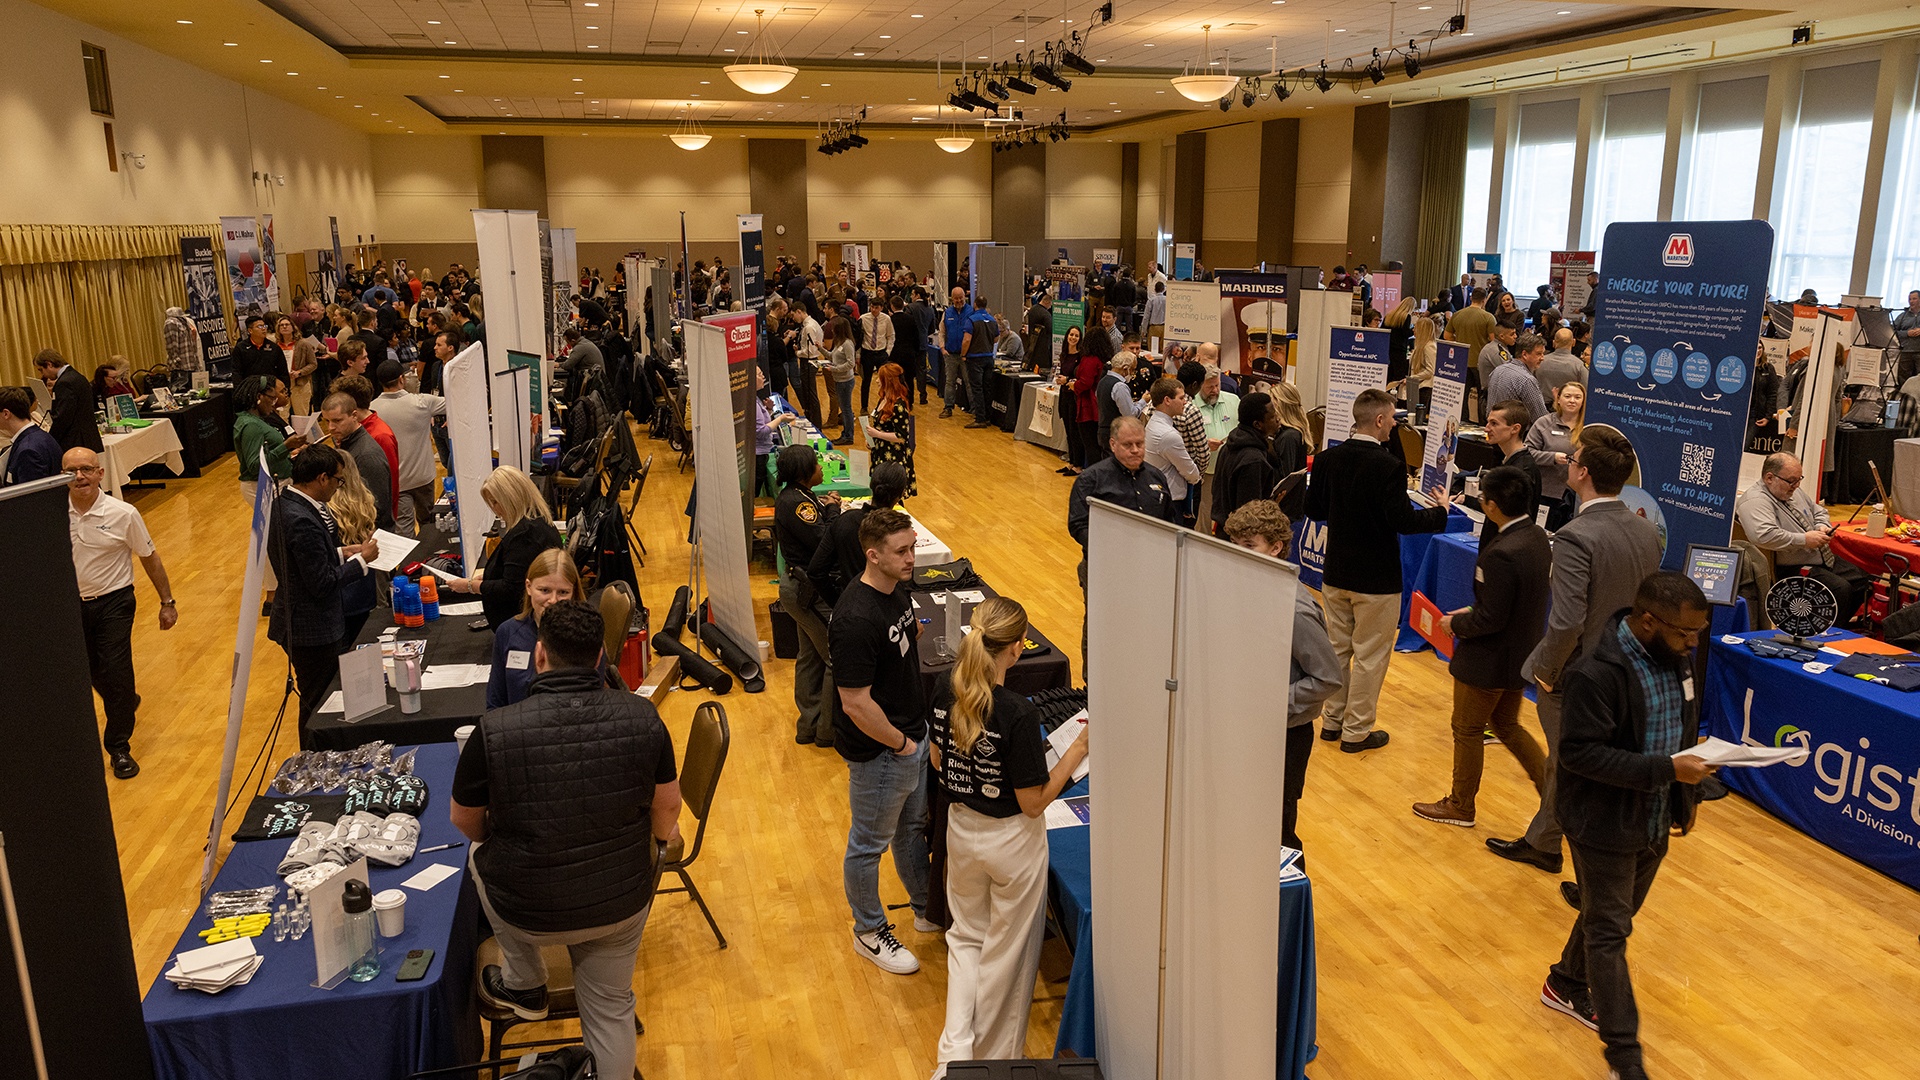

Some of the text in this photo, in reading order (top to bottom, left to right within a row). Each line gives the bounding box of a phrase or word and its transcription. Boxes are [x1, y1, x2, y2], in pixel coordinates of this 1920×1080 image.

[195, 249, 212, 257] Buckle
[1668, 239, 1689, 255] M
[1222, 284, 1284, 294] MARINES
[1607, 277, 1749, 300] ENERGIZE YOUR FUTURE!
[1170, 311, 1199, 321] Enriching
[197, 318, 227, 333] DISCOVER
[212, 330, 228, 344] YOUR
[731, 326, 752, 343] Gilbane
[208, 344, 231, 360] CAREER
[1617, 392, 1633, 401] exciting
[1645, 397, 1673, 406] opportunities
[1711, 407, 1733, 416] business.
[1608, 402, 1713, 431] From IT, HR, Marketing, Accounting
[1628, 417, 1661, 432] Engineering
[1662, 425, 1674, 433] and
[1674, 428, 1693, 436] more!
[1662, 482, 1726, 507] SCAN TO APPLY
[1665, 497, 1675, 505] visit
[1675, 501, 1726, 519] www.JoinMPC.com
[1694, 567, 1728, 575] SOLUTIONS
[948, 758, 971, 773] Riobel
[948, 770, 973, 783] ROHL
[948, 782, 974, 794] Schaub
[1842, 804, 1914, 848] A Division
